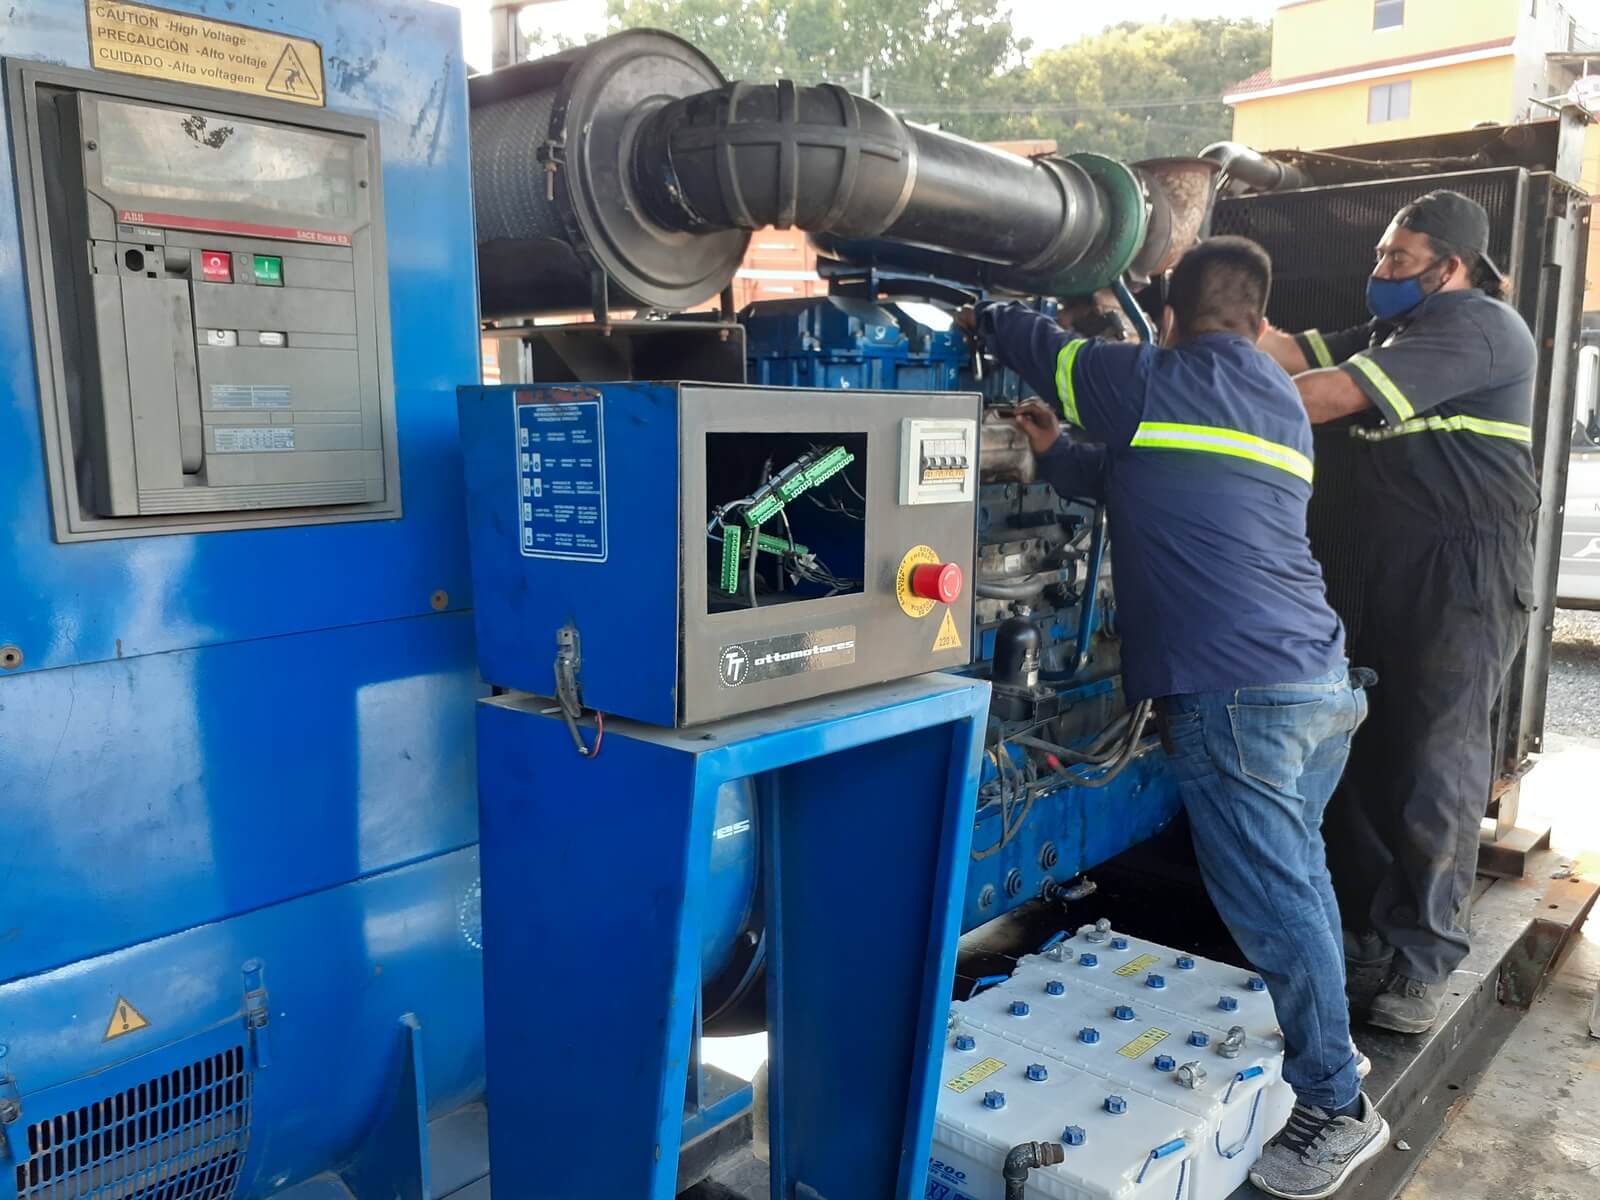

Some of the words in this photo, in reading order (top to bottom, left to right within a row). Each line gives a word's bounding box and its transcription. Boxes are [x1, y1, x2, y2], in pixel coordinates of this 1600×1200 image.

[95, 6, 159, 28] CAUTION
[202, 27, 247, 46] Voltage
[99, 47, 164, 68] CUIDADO
[200, 65, 255, 85] voltagem
[228, 53, 268, 69] voltaje
